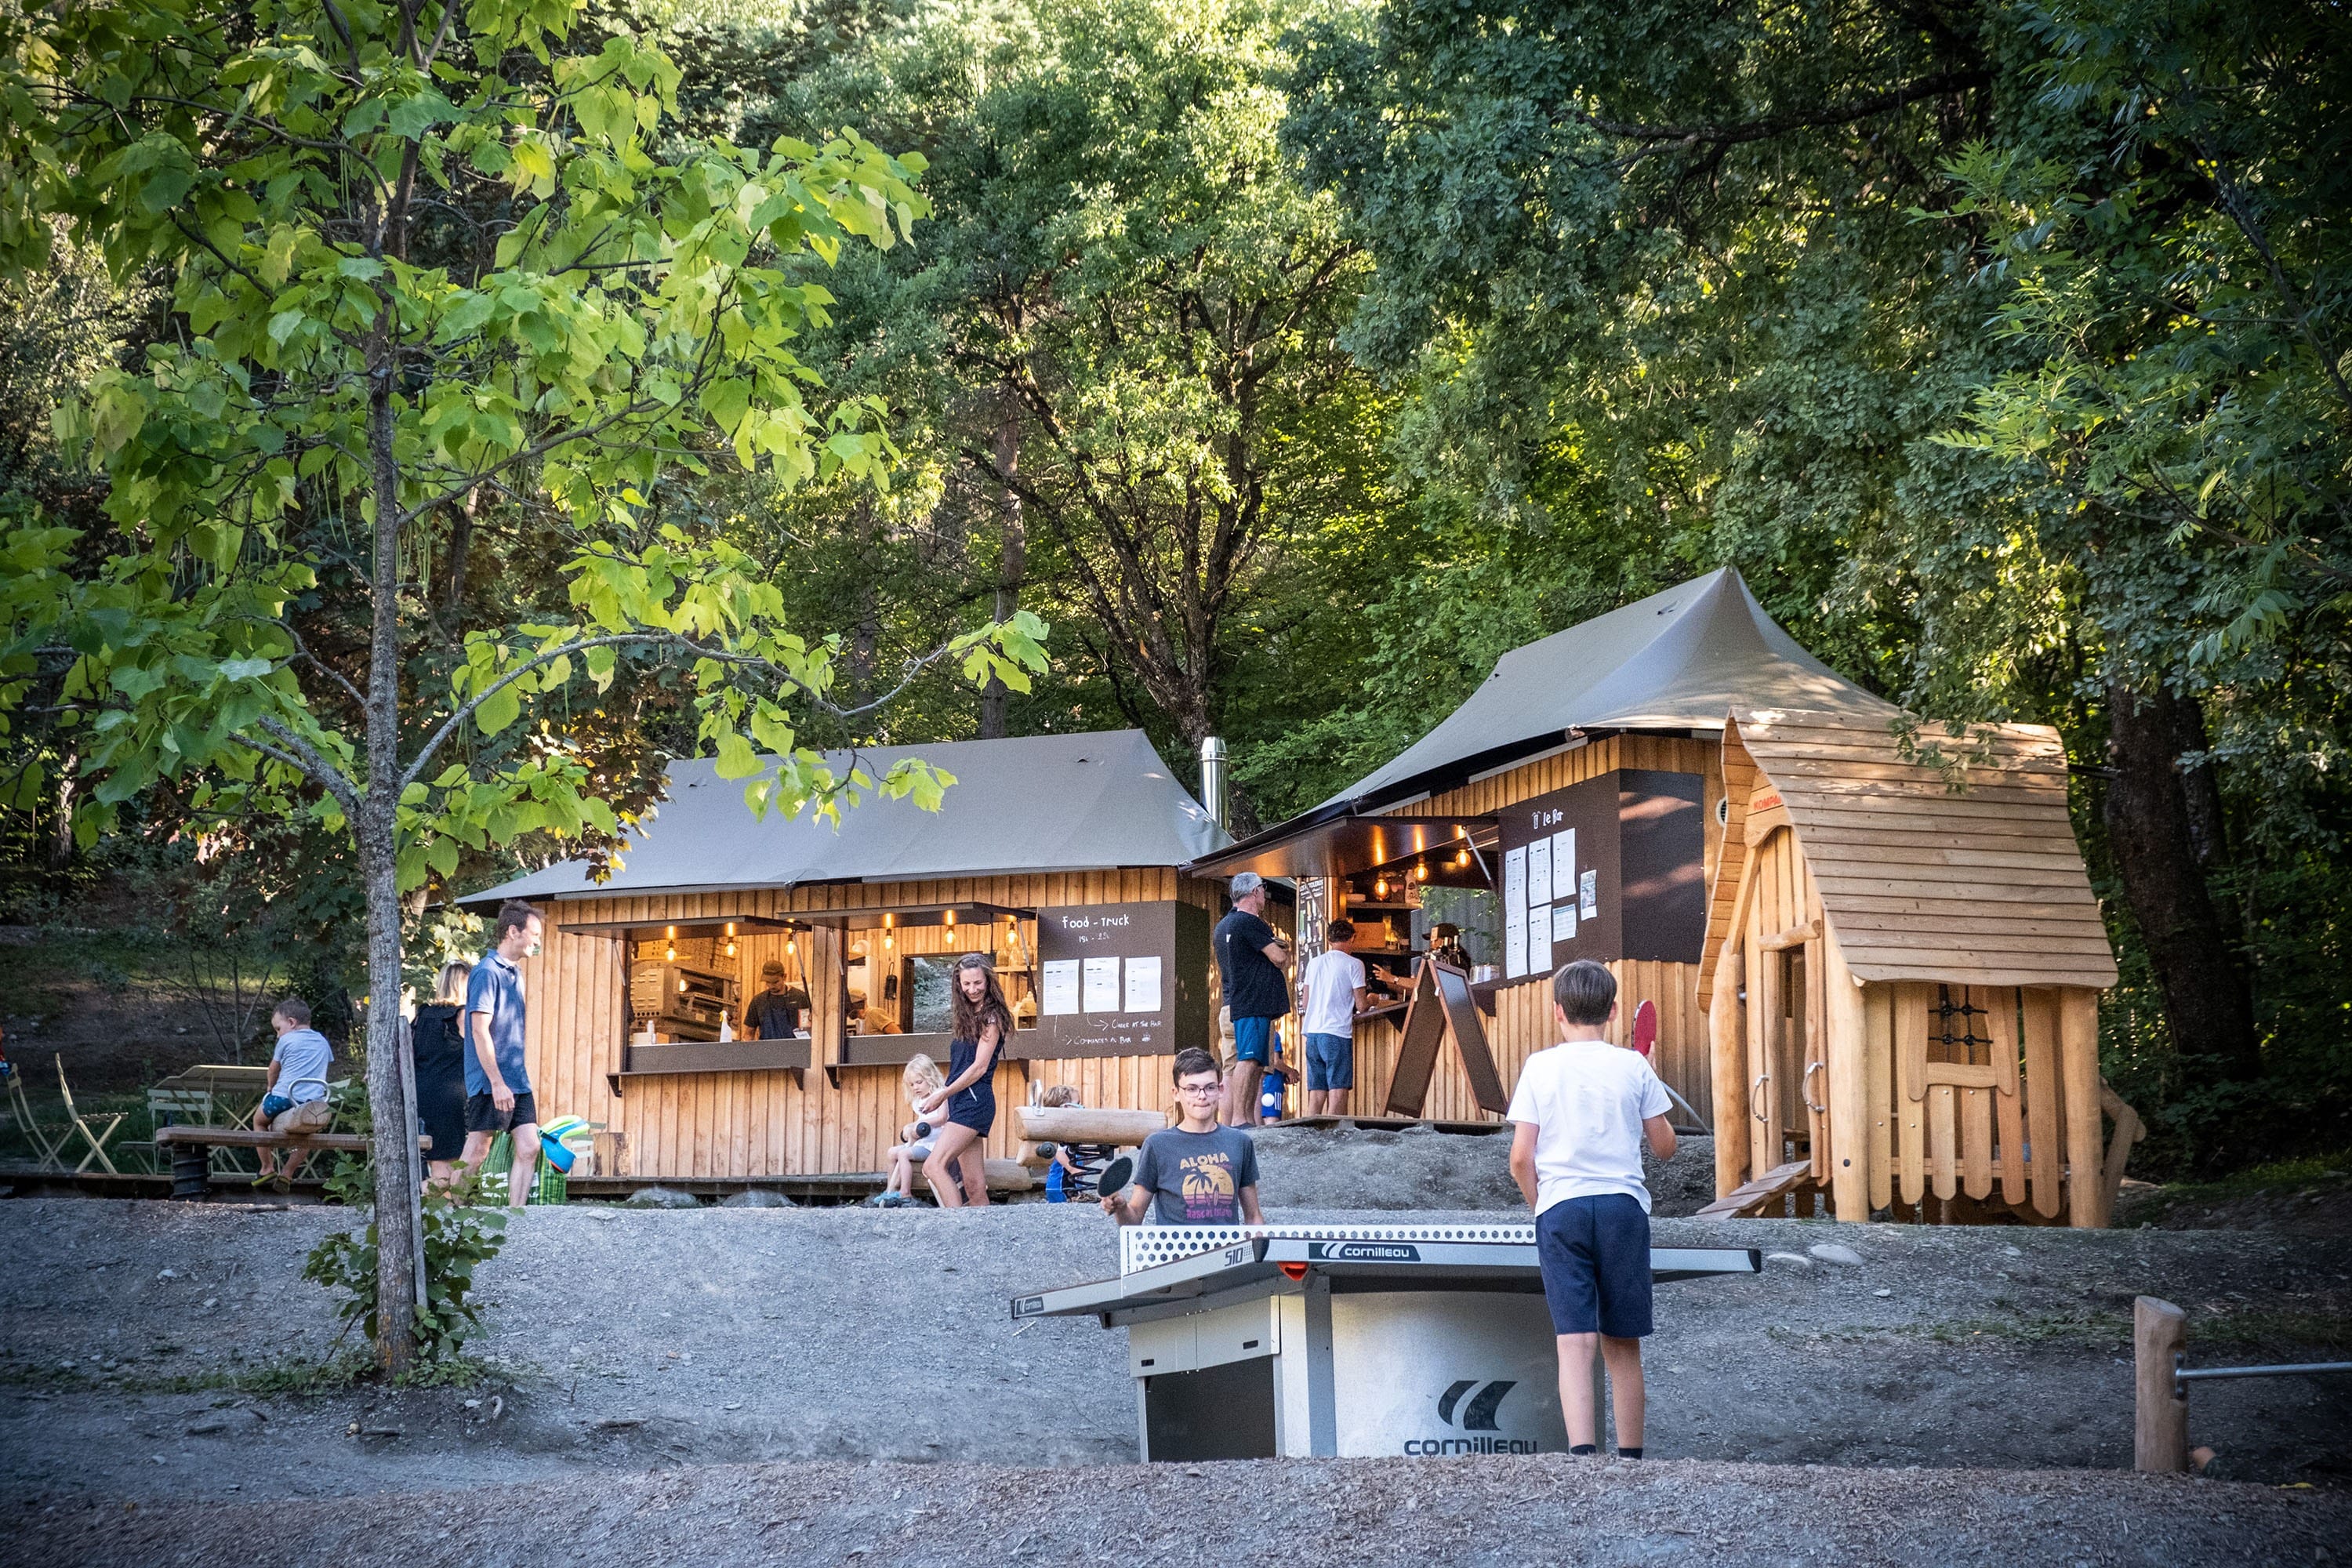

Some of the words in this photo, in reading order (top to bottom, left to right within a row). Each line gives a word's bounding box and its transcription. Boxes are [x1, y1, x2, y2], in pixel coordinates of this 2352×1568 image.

[1180, 1152, 1230, 1170] ALOHA
[1344, 1246, 1410, 1258] cornilleau
[1403, 1436, 1537, 1456] cornilleau
